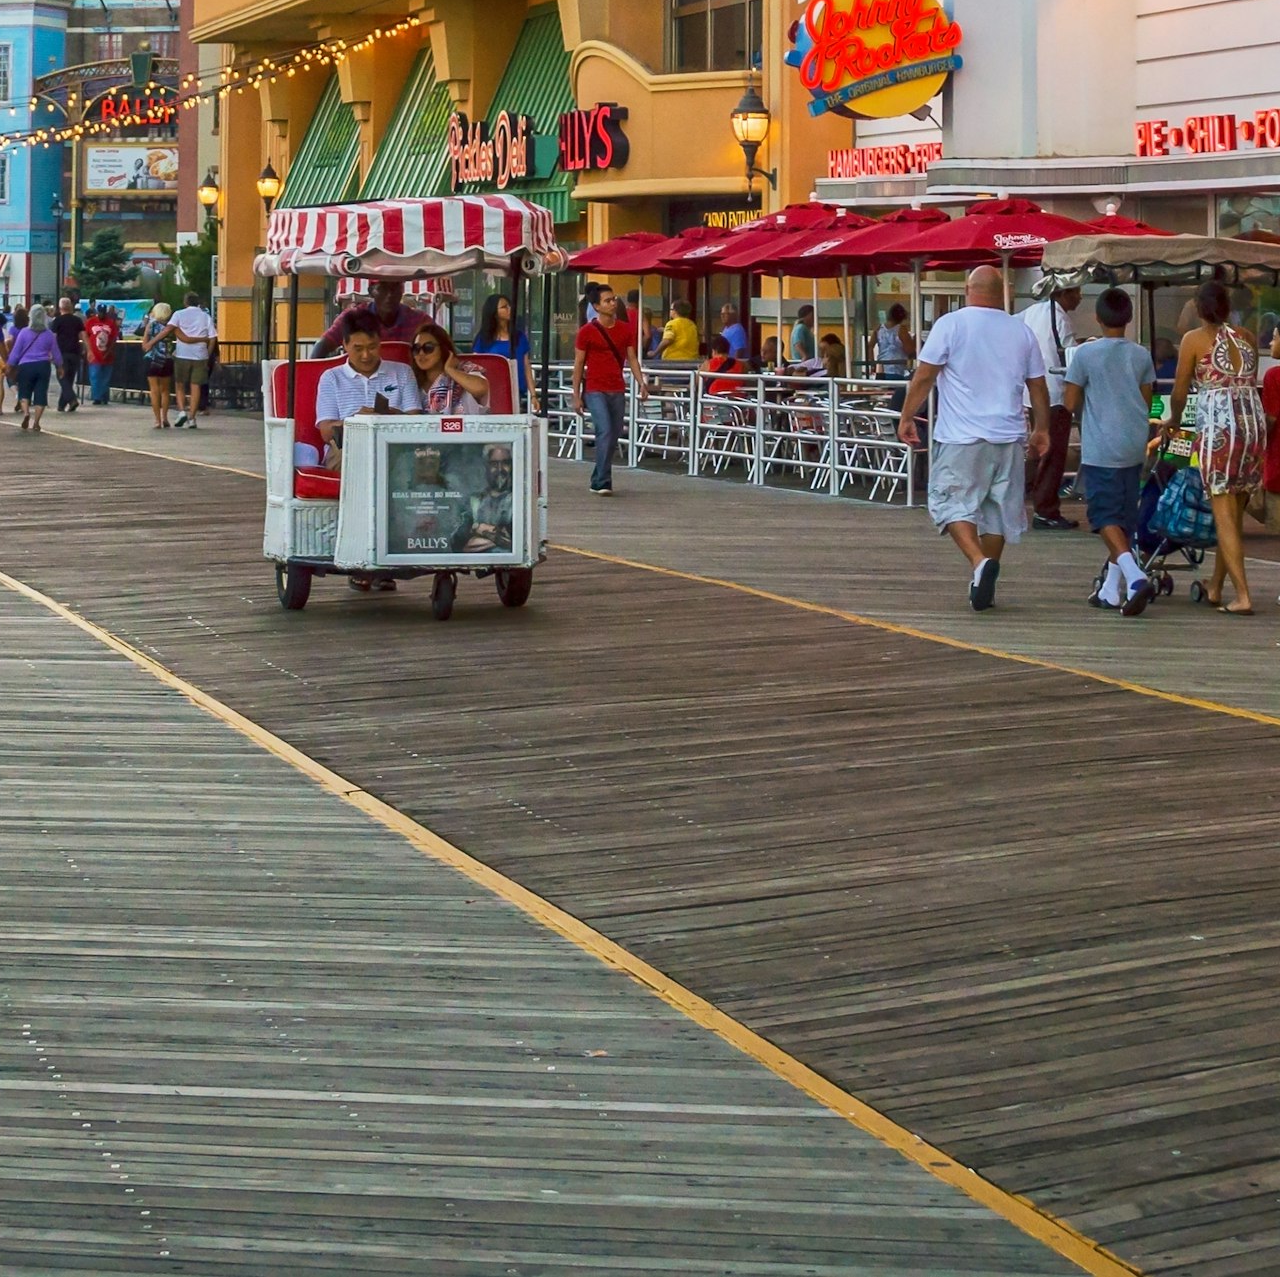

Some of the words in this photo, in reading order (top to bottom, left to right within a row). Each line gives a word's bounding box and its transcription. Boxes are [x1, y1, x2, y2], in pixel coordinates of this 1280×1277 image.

[821, 17, 963, 91] Rockets
[826, 91, 843, 108] THE
[848, 74, 892, 99] ORIGINAL
[448, 112, 494, 194] Pickles
[495, 110, 527, 190] Deli
[1136, 120, 1169, 157] PIE
[1184, 114, 1238, 156] CHILI
[827, 144, 907, 178] HAMBURGERS
[915, 143, 943, 174] FRIE
[443, 422, 460, 430] 326
